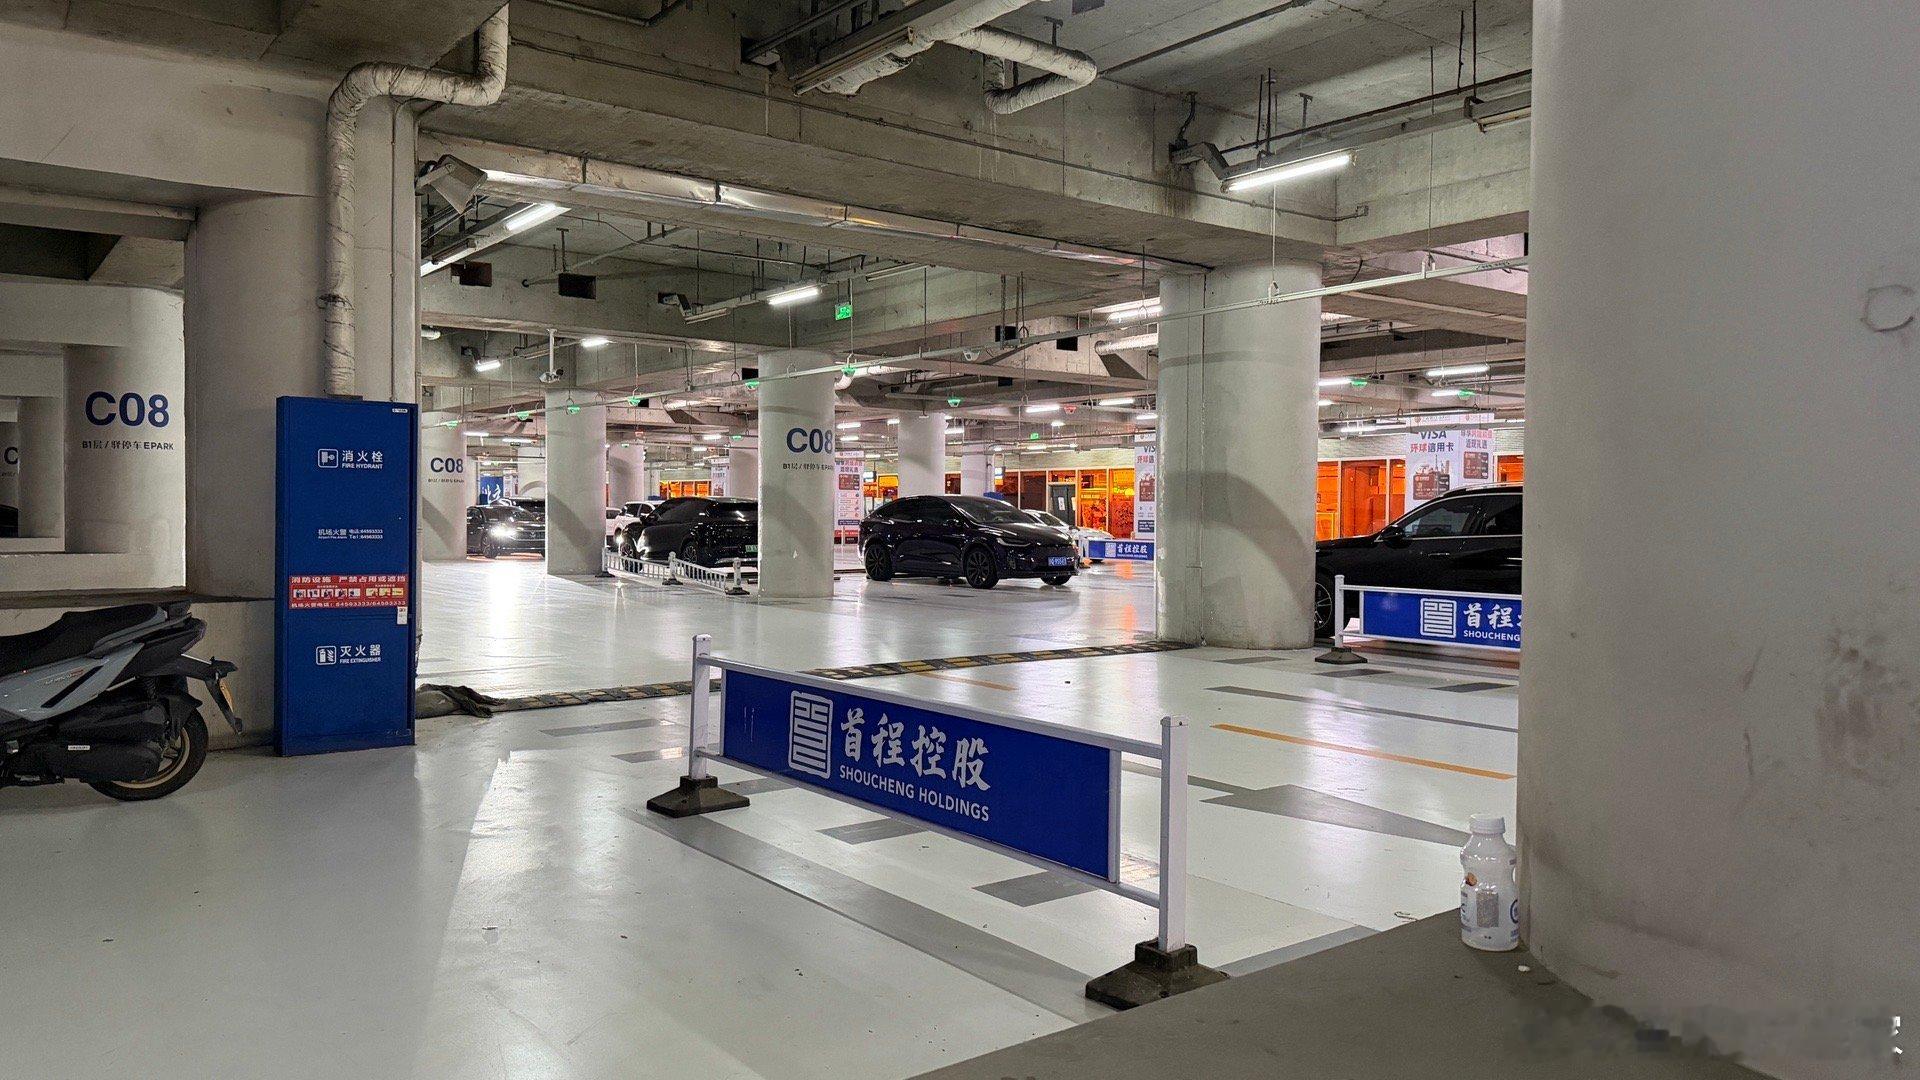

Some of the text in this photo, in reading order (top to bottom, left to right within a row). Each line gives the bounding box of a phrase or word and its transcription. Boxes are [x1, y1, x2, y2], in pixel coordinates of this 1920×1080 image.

[85, 391, 170, 428] C08
[143, 441, 174, 450] EPARK
[786, 428, 833, 454] C08
[1410, 442, 1454, 453] 环球信用卡
[342, 450, 383, 463] 消火栓
[430, 457, 464, 473] C08
[1463, 602, 1522, 630] 首程
[1463, 629, 1521, 642] SHOUCHENG
[340, 644, 381, 657] 灭火器
[840, 707, 991, 791] 首程控股
[839, 764, 989, 822] SHOUCHENG HOLDINGS
